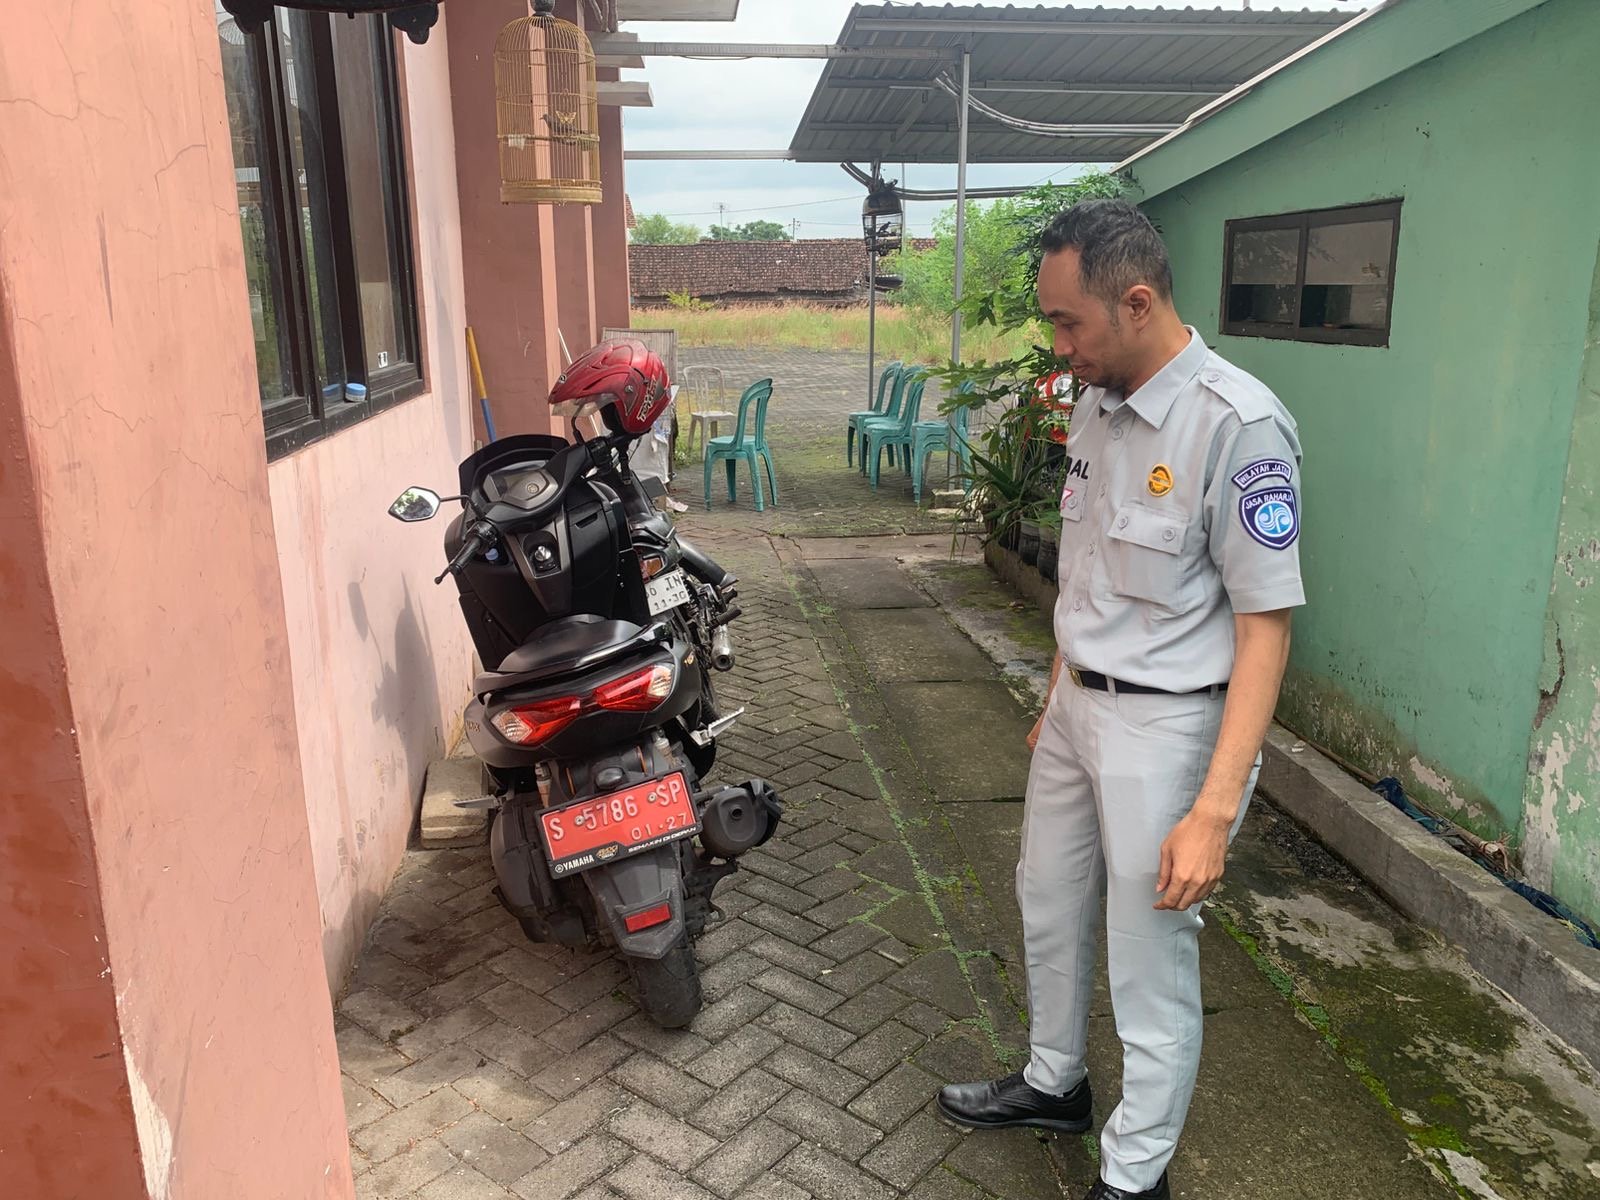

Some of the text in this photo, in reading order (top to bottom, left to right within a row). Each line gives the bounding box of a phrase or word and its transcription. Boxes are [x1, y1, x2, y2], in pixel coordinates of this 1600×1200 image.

[1238, 464, 1269, 484] WILAYAH
[1245, 497, 1263, 510] JASA
[549, 780, 681, 841] S 5786 SP
[563, 854, 595, 871] YAMAHA
